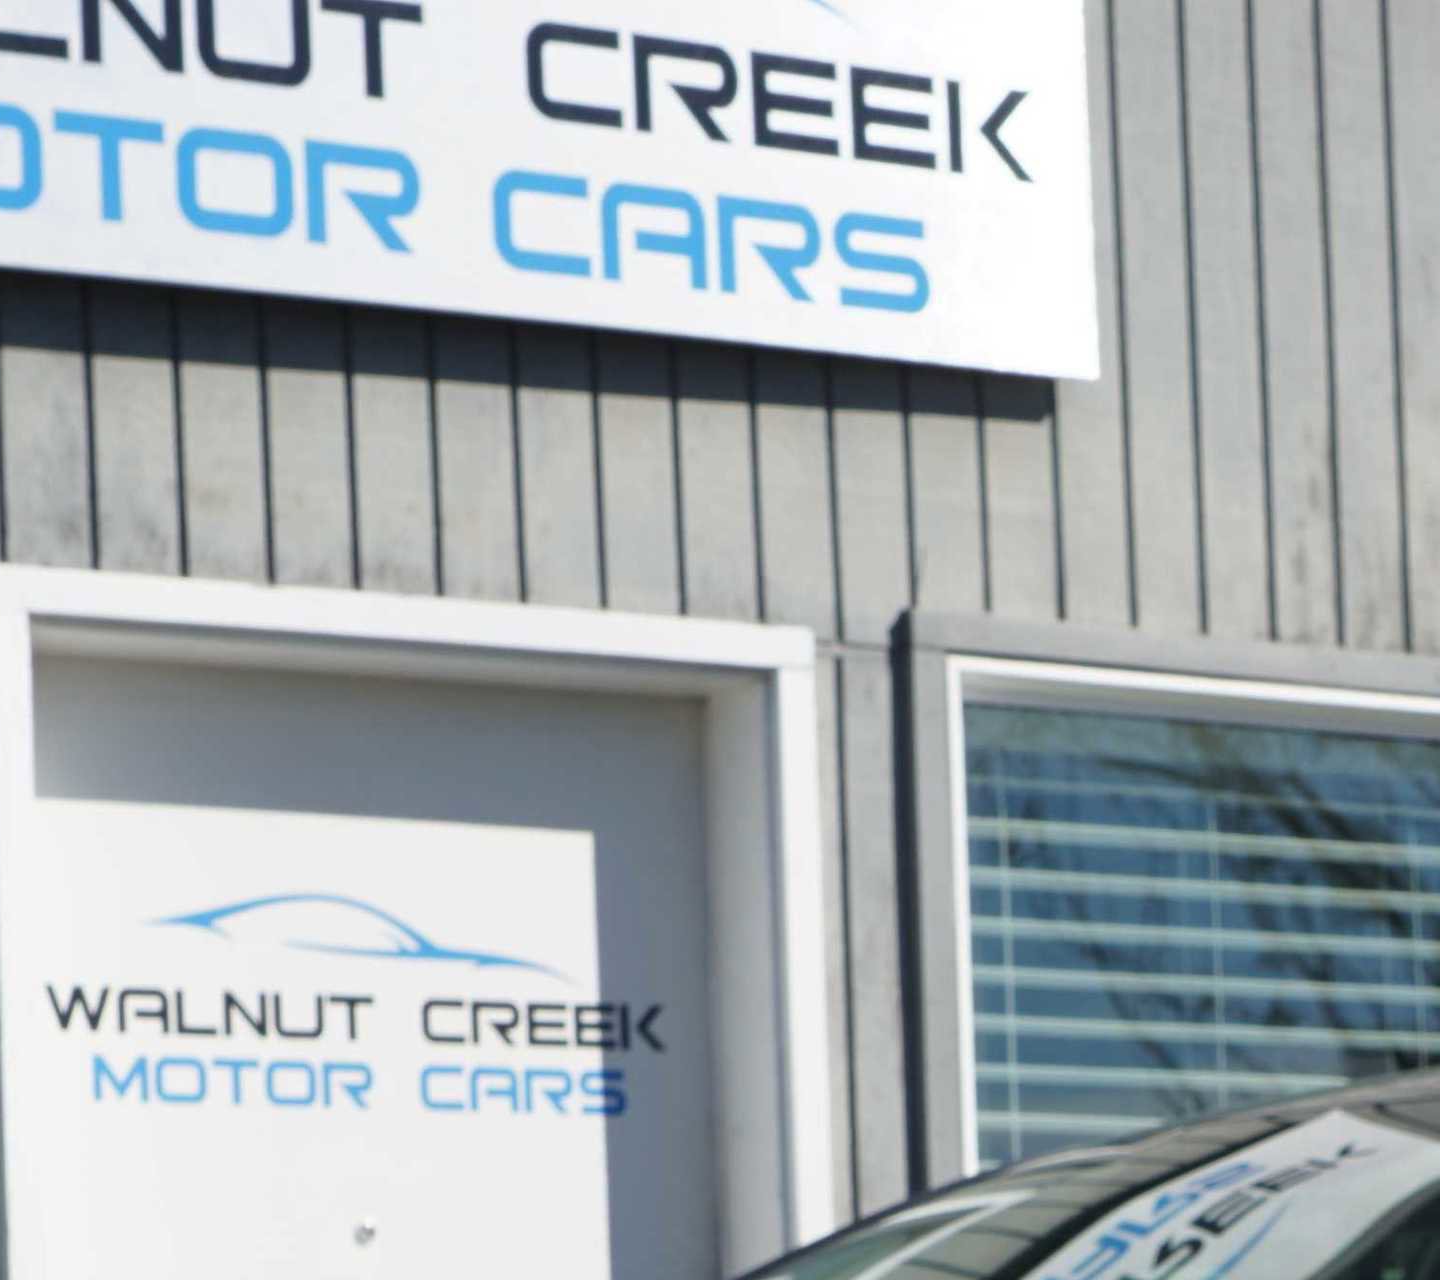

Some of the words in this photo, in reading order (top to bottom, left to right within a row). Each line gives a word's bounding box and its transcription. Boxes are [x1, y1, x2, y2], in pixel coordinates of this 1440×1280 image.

[525, 21, 1034, 184] CREEK
[492, 169, 931, 315] CARS
[46, 983, 376, 1042] WALNUT
[421, 1000, 667, 1054] CREEK
[92, 1054, 375, 1110] MOTOR
[419, 1064, 628, 1117] CARS
